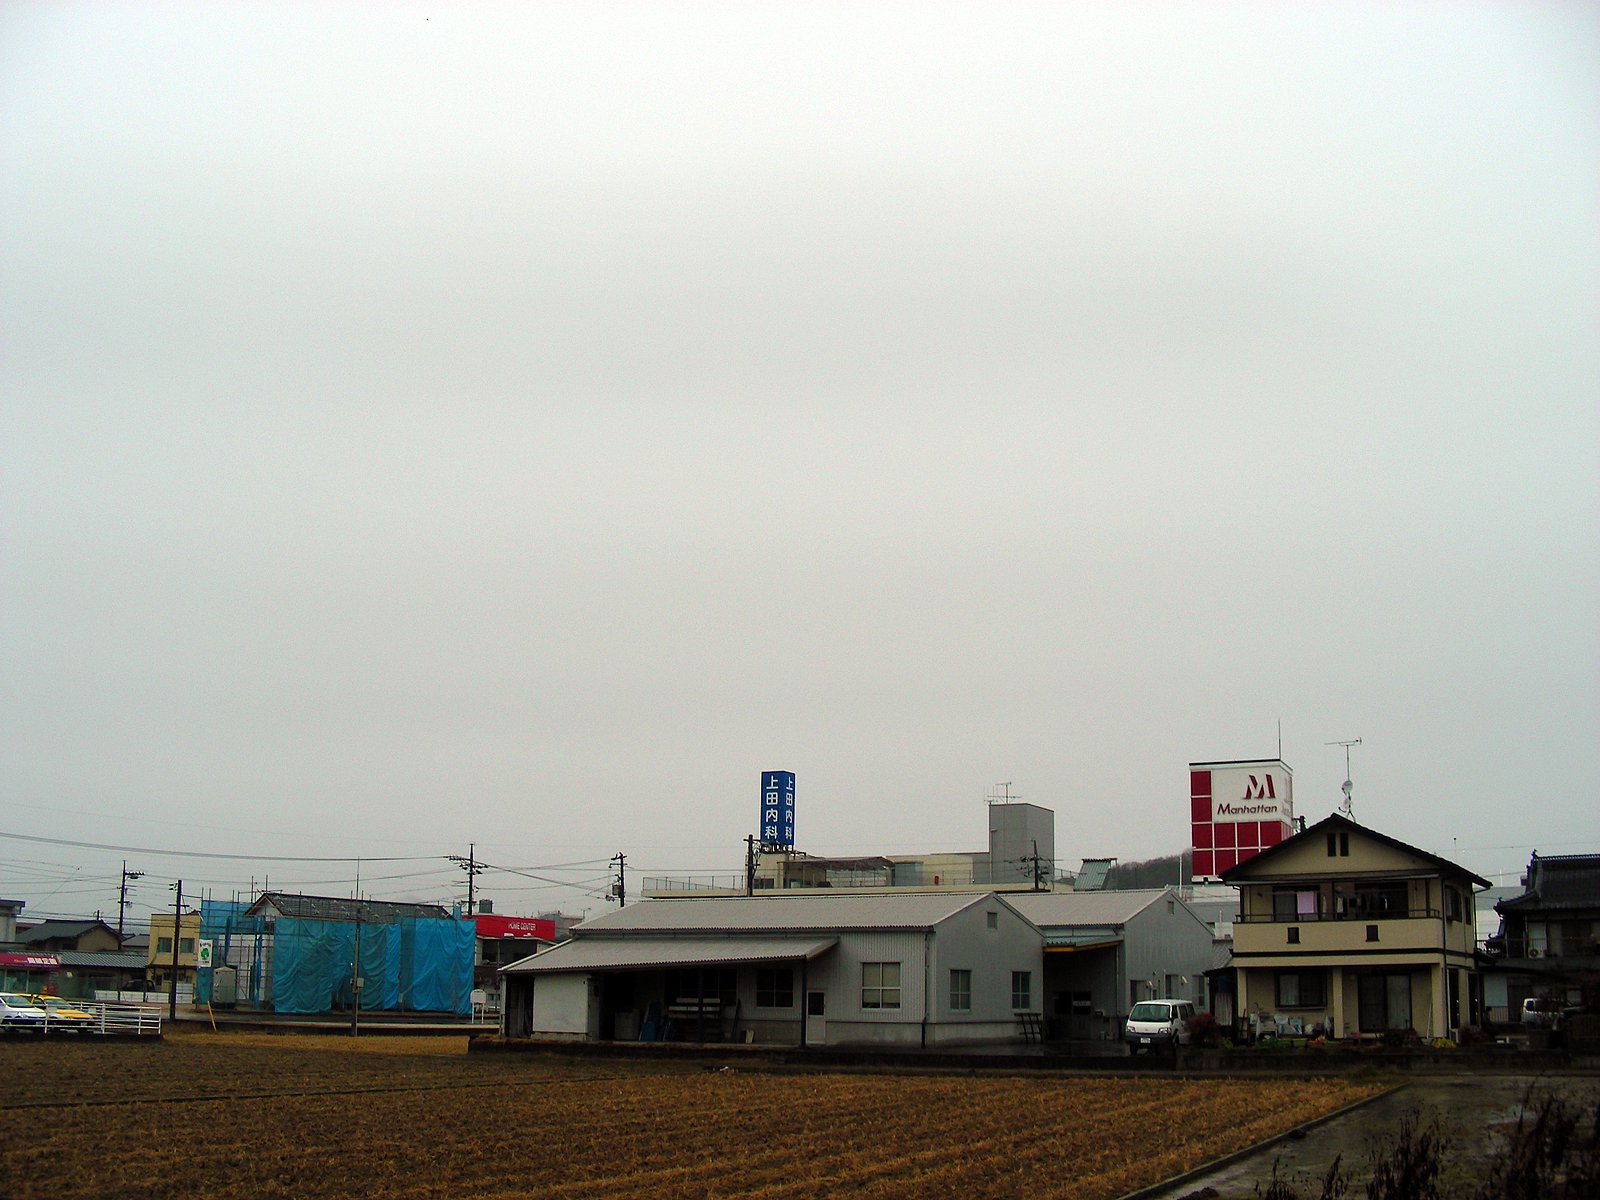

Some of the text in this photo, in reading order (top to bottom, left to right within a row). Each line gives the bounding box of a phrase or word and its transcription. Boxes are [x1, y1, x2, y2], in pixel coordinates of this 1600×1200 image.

[765, 775, 779, 840] 上田内科
[785, 776, 793, 840] 上田内科
[1217, 803, 1278, 815] Manhattan
[509, 922, 536, 931] HOME CENTER
